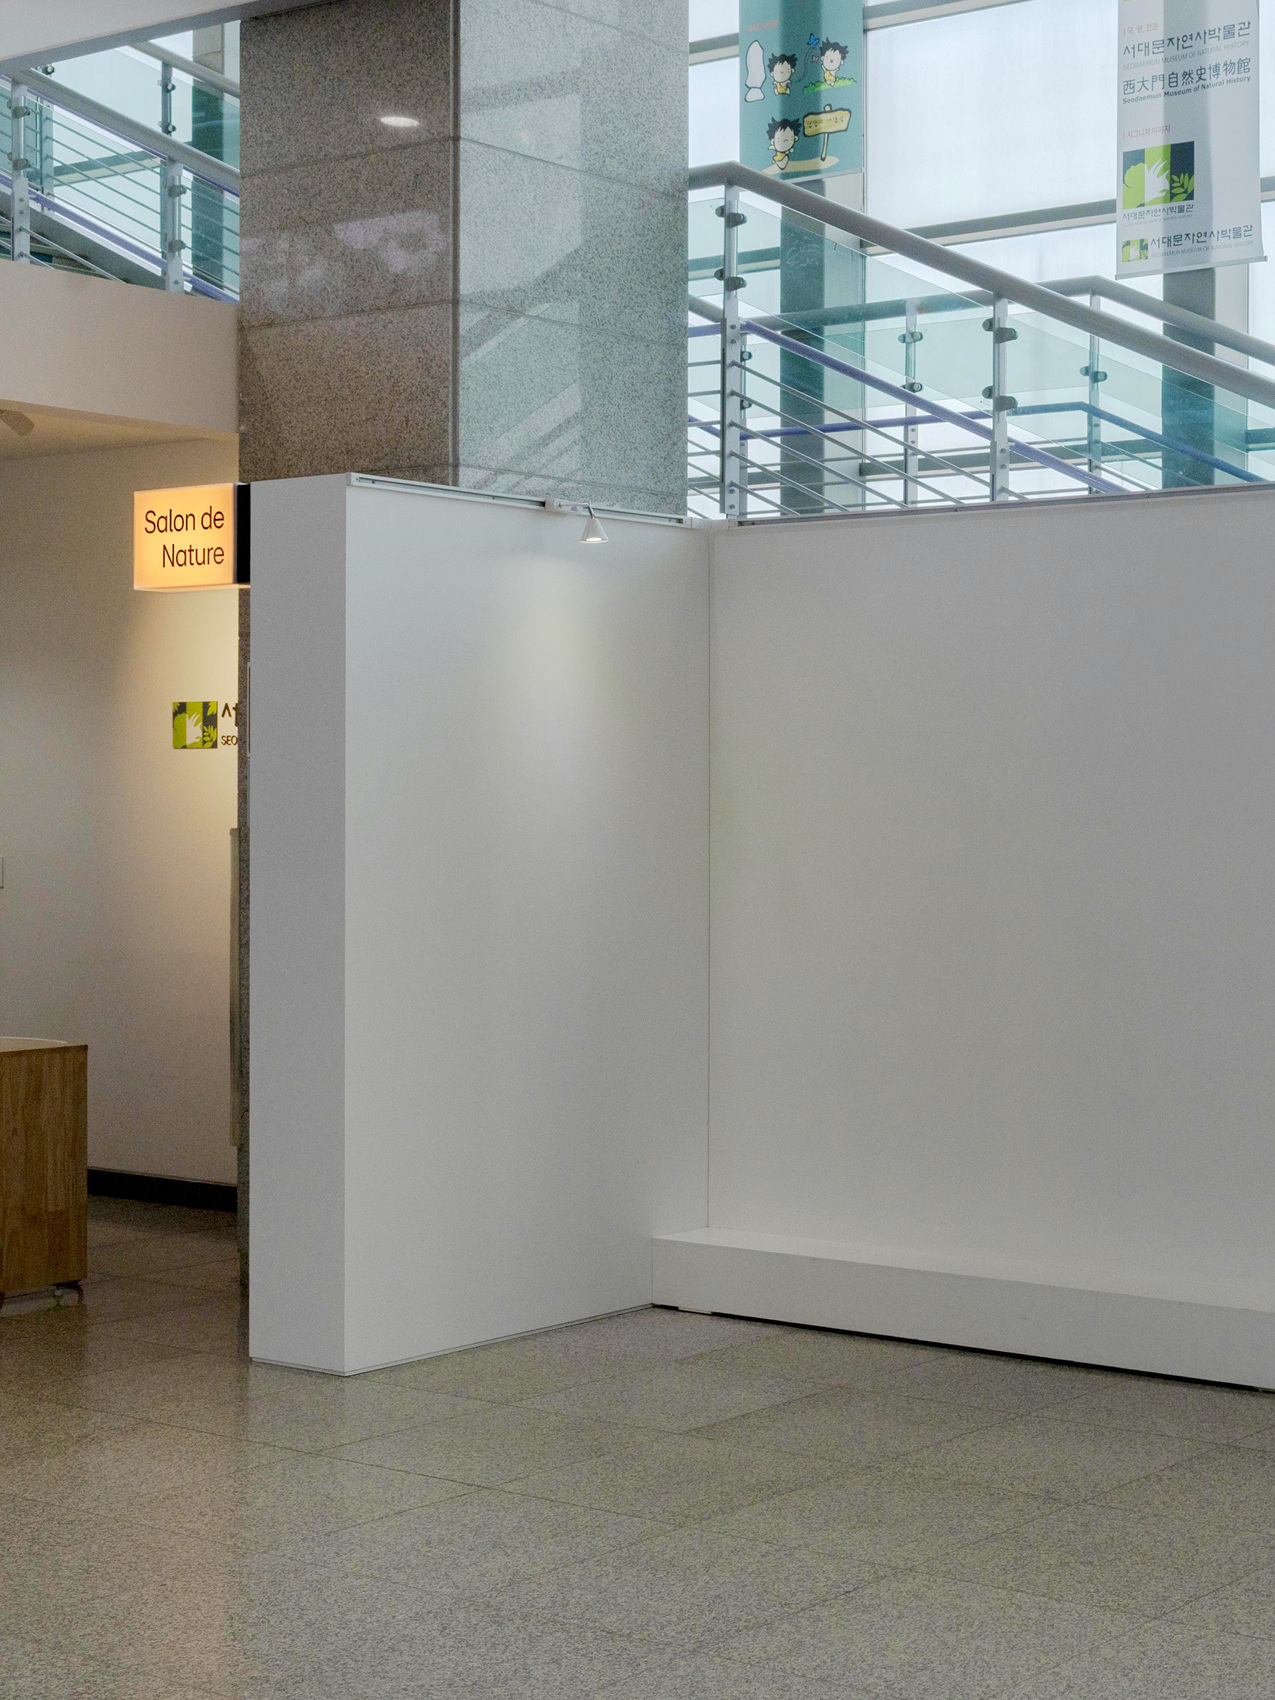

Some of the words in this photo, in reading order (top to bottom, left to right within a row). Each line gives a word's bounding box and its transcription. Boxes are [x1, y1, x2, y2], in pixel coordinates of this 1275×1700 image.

[1123, 21, 1251, 59] 서대문자연사박물관
[1163, 53, 1188, 64] MUSEUM
[1189, 51, 1197, 59] OF
[1197, 46, 1223, 58] NATURAL
[1224, 40, 1250, 51] HISTORY
[1122, 57, 1251, 96] 西大門自然史博物館
[1122, 92, 1162, 105] Seodaemun
[1163, 87, 1192, 98] Museum
[1193, 85, 1201, 93] of
[1201, 79, 1225, 91] Natural
[1225, 75, 1251, 86] History
[1122, 204, 1194, 221] 서대문자연사박물관
[1150, 224, 1253, 249] 서대문자연사박물관
[144, 508, 196, 535] Salon
[200, 505, 225, 530] de
[162, 543, 225, 568] Nature
